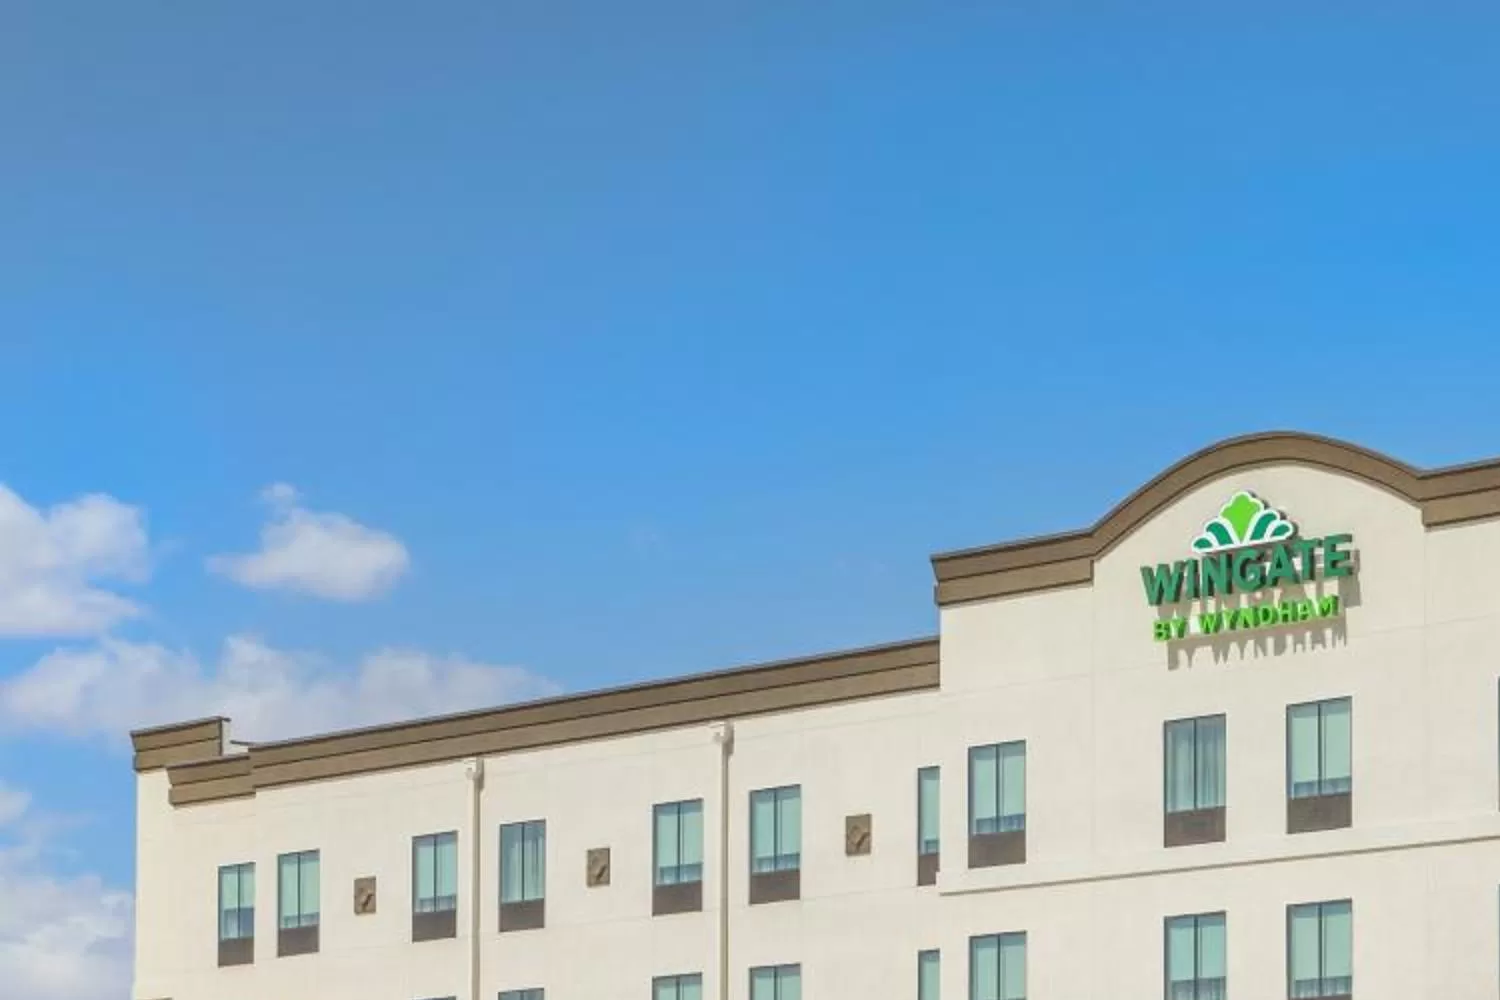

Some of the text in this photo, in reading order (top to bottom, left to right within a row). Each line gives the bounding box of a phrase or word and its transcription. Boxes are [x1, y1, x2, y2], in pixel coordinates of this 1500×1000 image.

[1139, 533, 1354, 606] WINGATE
[1152, 595, 1340, 642] BY WYNDHAM
